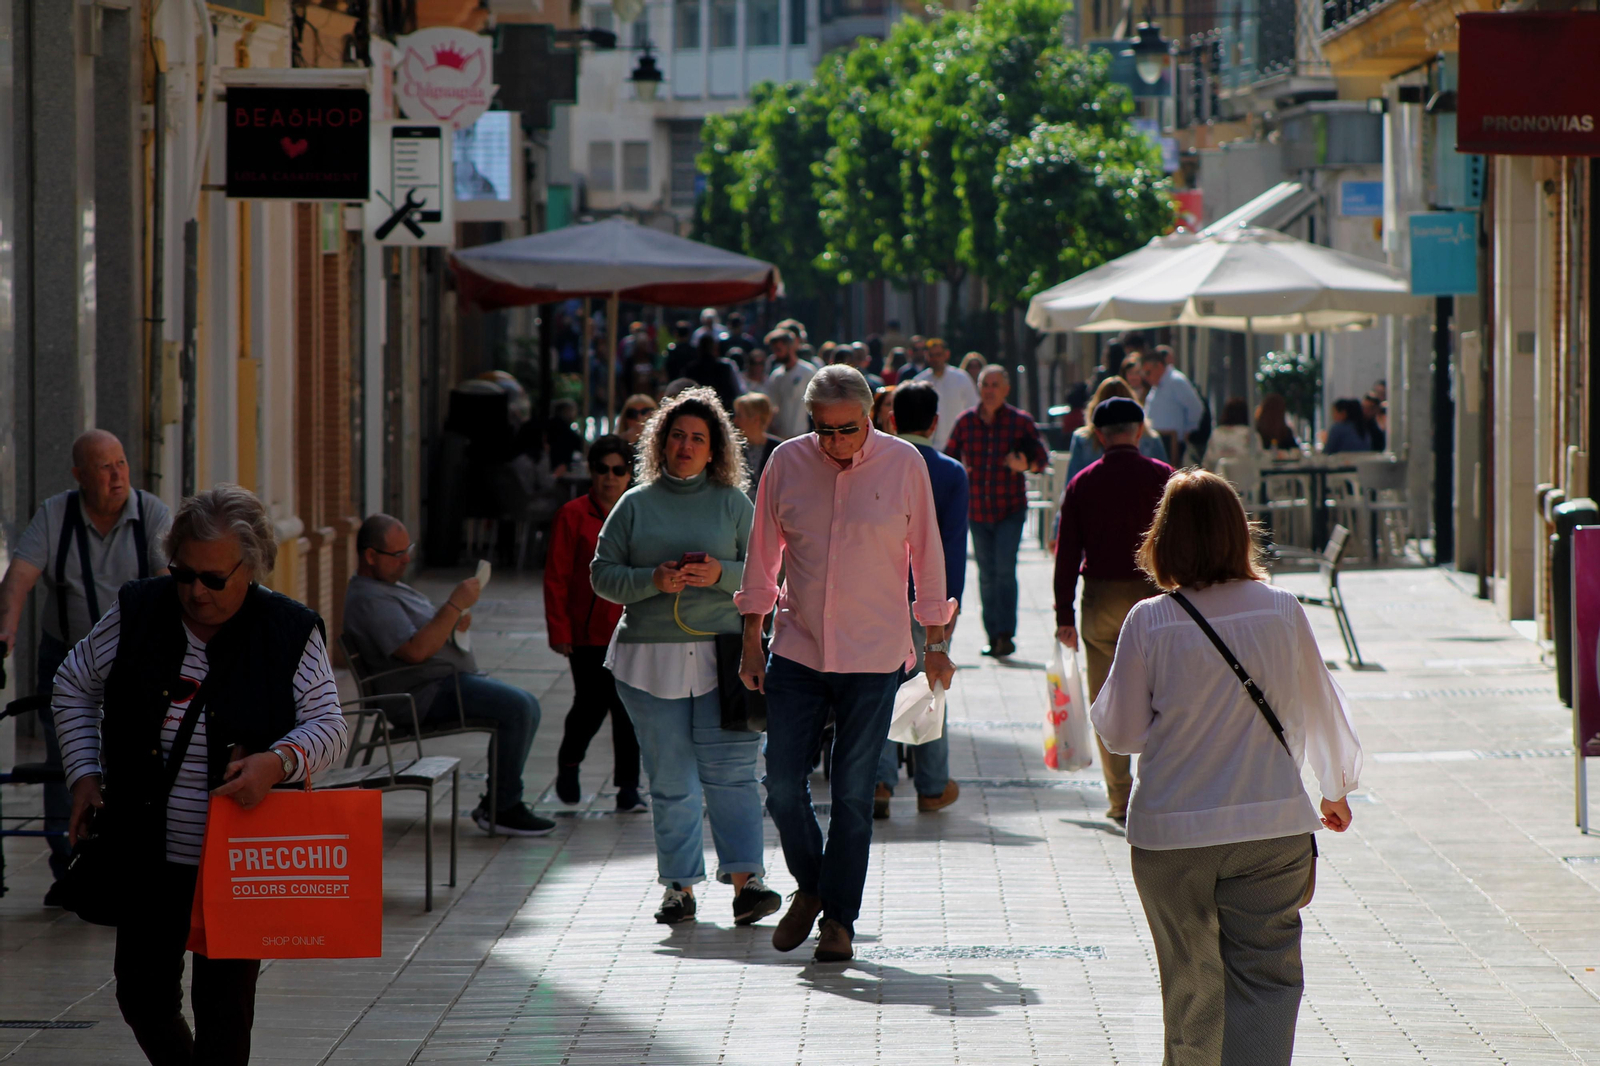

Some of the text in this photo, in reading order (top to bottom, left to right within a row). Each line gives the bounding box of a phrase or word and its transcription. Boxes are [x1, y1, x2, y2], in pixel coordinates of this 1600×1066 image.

[235, 107, 363, 127] BEASHOP
[1482, 115, 1594, 132] PRONOVIAS
[228, 845, 348, 871] PRECCHIO
[232, 883, 349, 895] COLORS CONCEPT
[261, 936, 326, 946] SHOP ONLINE
